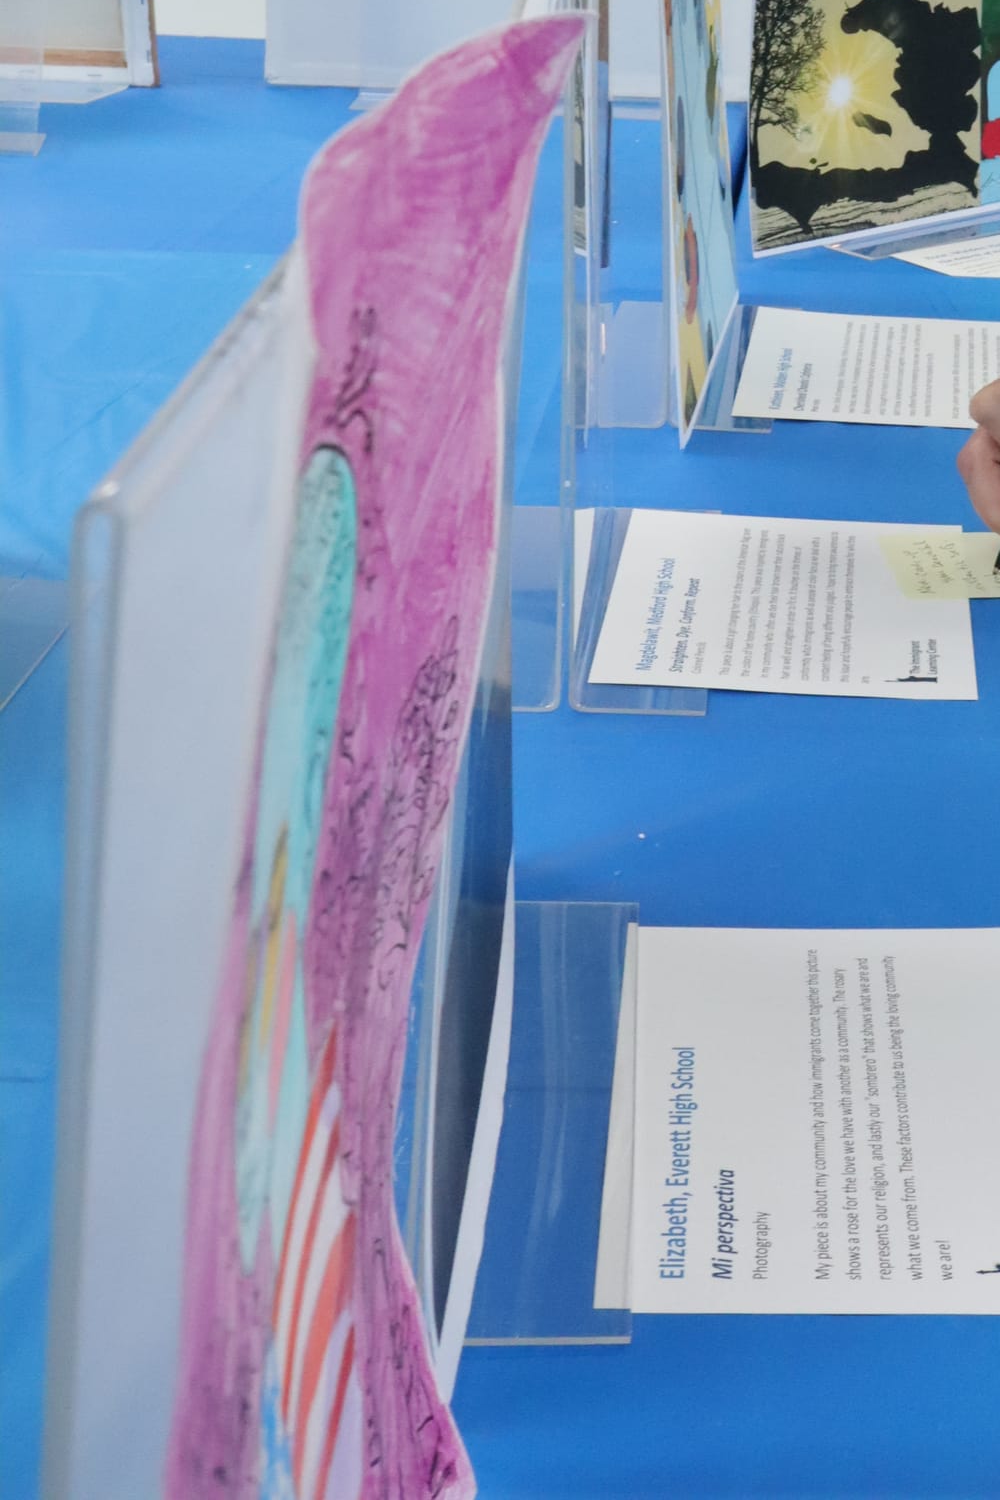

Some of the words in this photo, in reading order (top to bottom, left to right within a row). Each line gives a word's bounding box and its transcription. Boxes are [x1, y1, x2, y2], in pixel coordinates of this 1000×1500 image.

[657, 558, 675, 579] School
[652, 581, 674, 595] High
[684, 578, 699, 597] Repeat
[646, 596, 667, 625] Medford
[679, 599, 696, 624] Conform.
[675, 625, 692, 638] Dye.
[635, 627, 662, 671] Magdelawit,
[668, 640, 688, 673] Straighten.
[909, 641, 923, 664] Immigrant
[927, 639, 937, 653] Center
[909, 666, 920, 674] The
[927, 655, 939, 675] Learning
[807, 950, 820, 972] picture
[881, 956, 897, 992] community
[808, 987, 822, 1015] together
[885, 994, 900, 1013] loving
[861, 1014, 873, 1036] shows
[888, 1029, 904, 1049] being
[671, 1047, 695, 1089] School
[809, 1039, 824, 1080] immigrants
[837, 1065, 852, 1095] another
[892, 1071, 908, 1112] contribute
[669, 1094, 697, 1125] High
[840, 1117, 853, 1138] have
[867, 1120, 883, 1141] lastly
[896, 1115, 911, 1145] factors
[812, 1120, 828, 1170] community
[666, 1131, 691, 1186] Everett
[841, 1156, 856, 1174] love
[899, 1147, 913, 1172] These
[871, 1163, 889, 1200] religion,
[900, 1176, 917, 1201] from.
[714, 1169, 738, 1254] perspectiva
[813, 1190, 828, 1218] about
[846, 1213, 859, 1234] rose
[905, 1205, 919, 1231] come
[659, 1192, 692, 1279] Elizabeth,
[752, 1212, 771, 1280] Photography
[813, 1232, 832, 1259] piece
[846, 1246, 861, 1280] shows
[875, 1225, 894, 1280] represents
[712, 1258, 732, 1279] Mi
[814, 1263, 832, 1280] My
[907, 1253, 923, 1280] what
[941, 1264, 952, 1280] we
